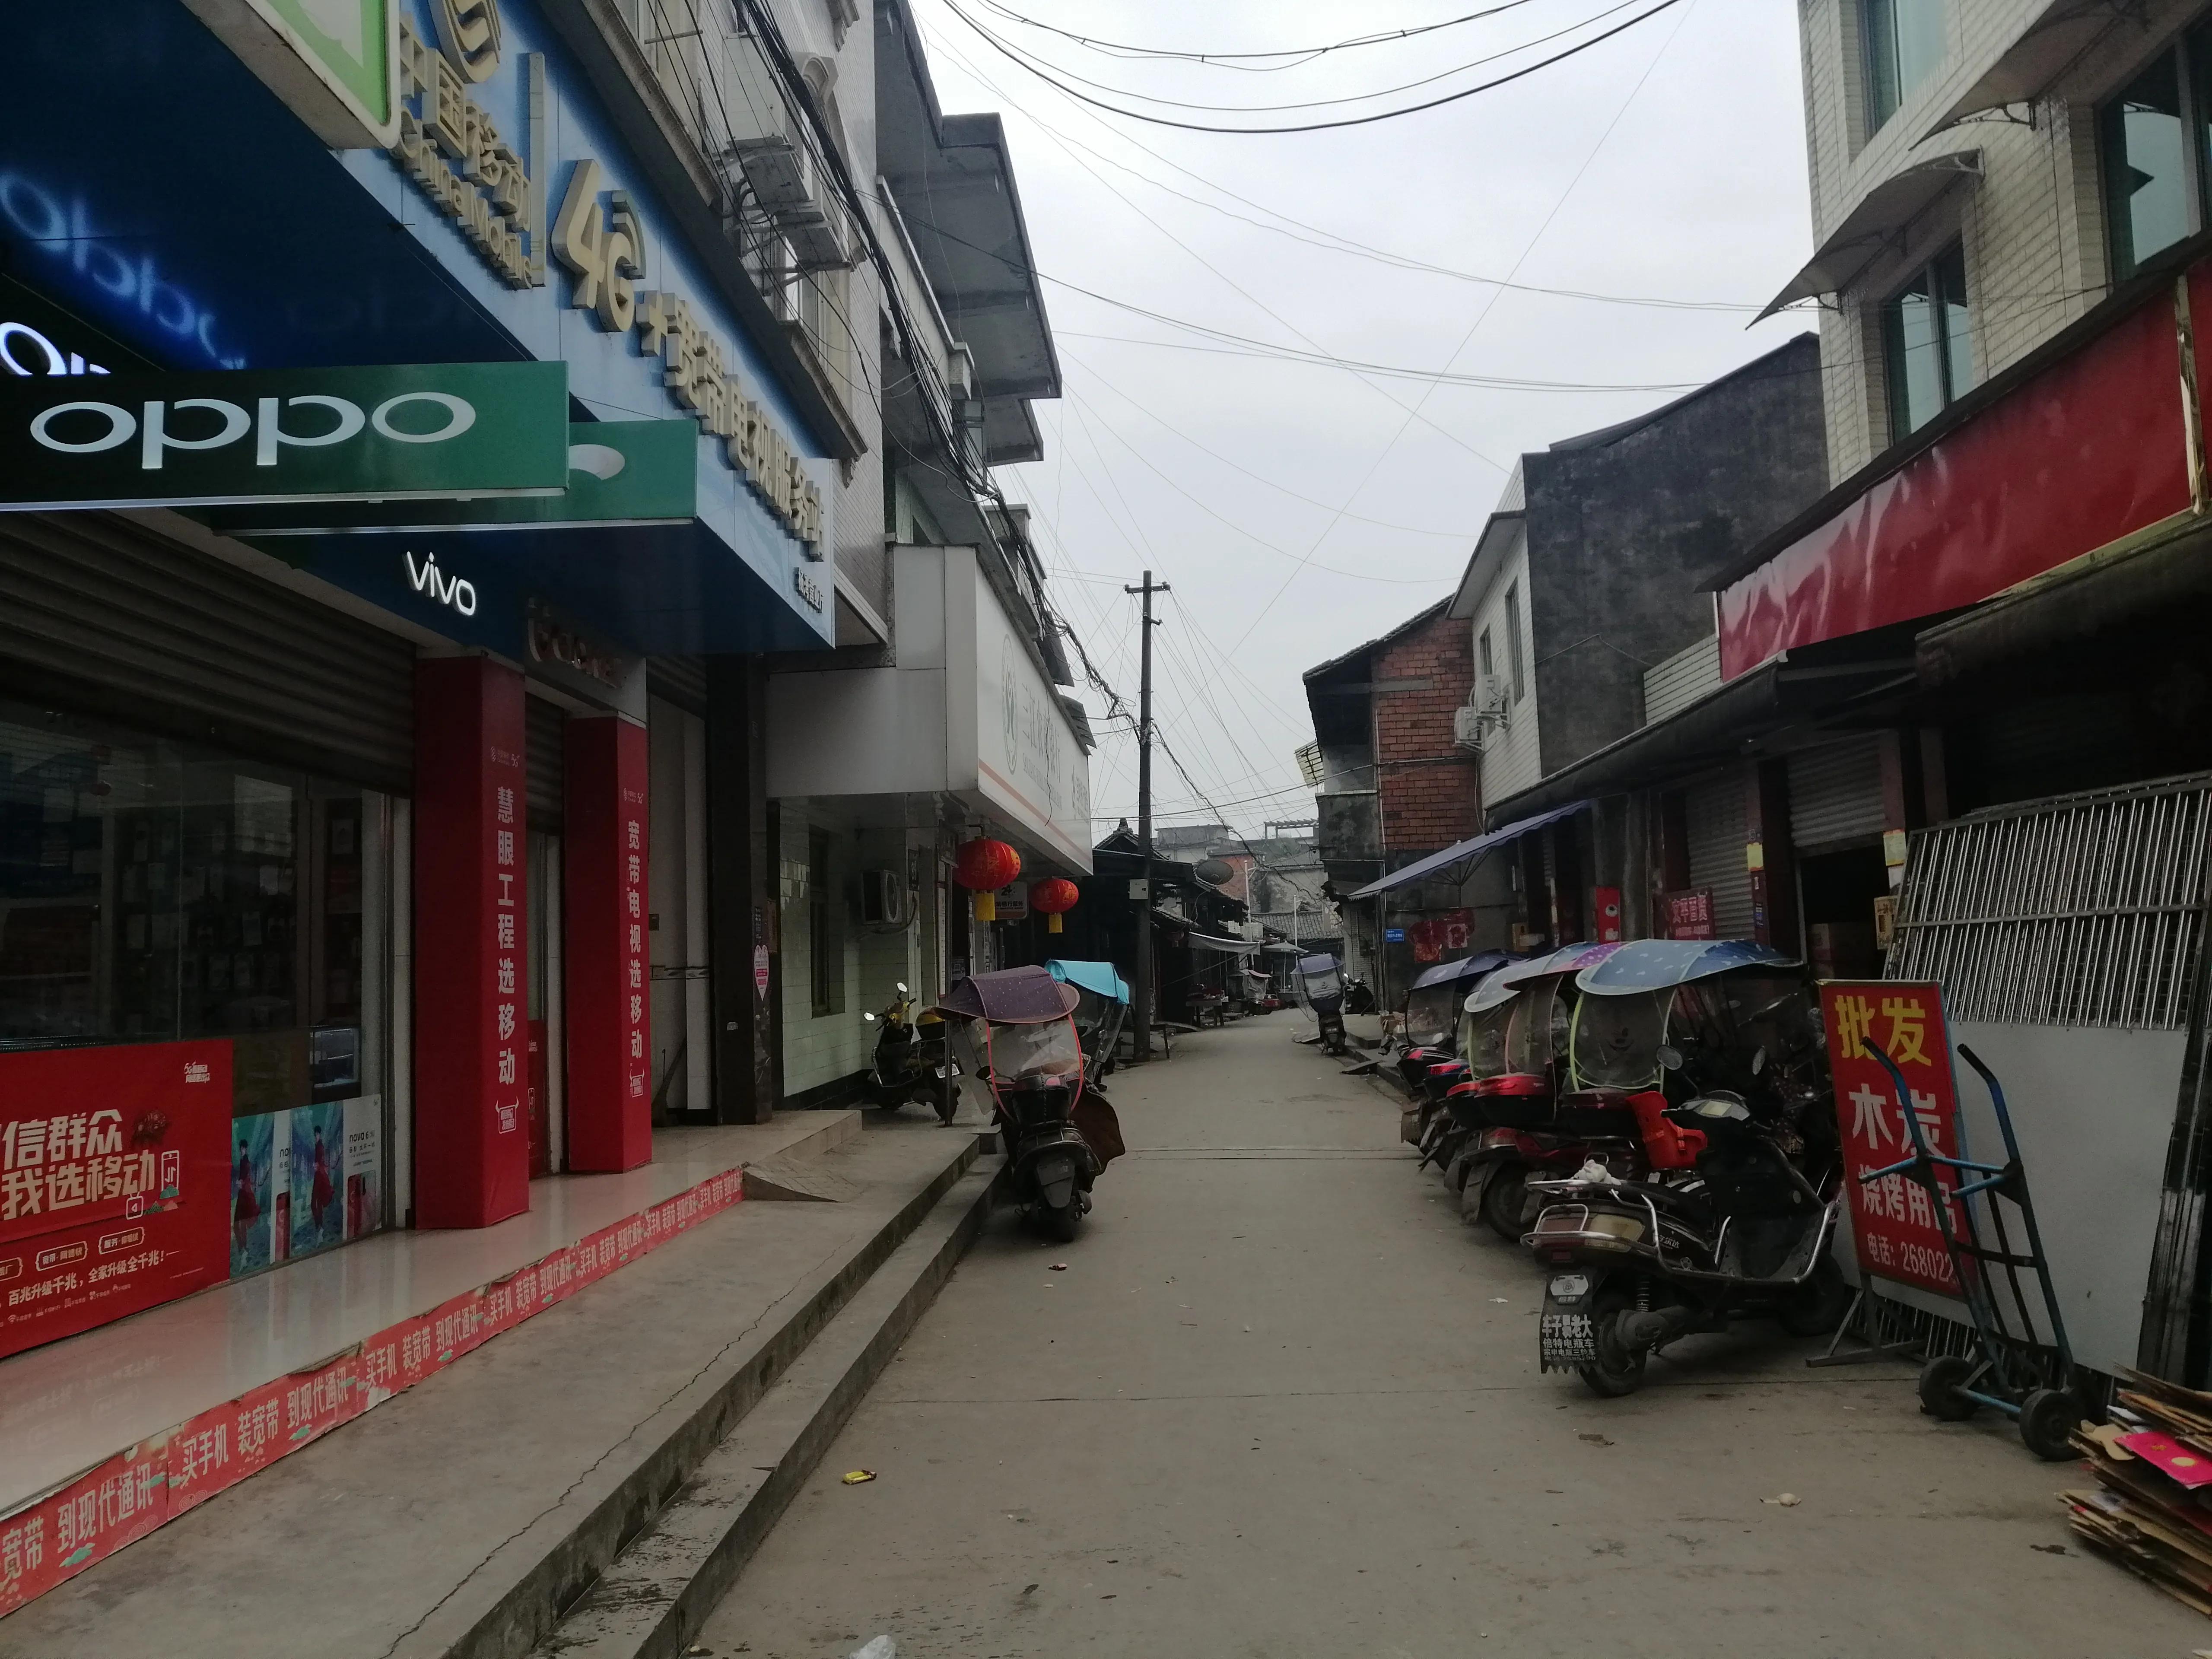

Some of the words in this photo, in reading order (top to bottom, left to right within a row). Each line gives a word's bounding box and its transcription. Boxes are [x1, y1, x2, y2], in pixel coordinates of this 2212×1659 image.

[406, 551, 476, 617] vivo
[497, 786, 515, 1085] 慧眼工程选移动
[628, 820, 643, 1060] 宽带电视选移动
[1835, 995, 1932, 1066] 批发
[1, 1108, 124, 1171] 信群众
[349, 1132, 364, 1143] nova
[1849, 1083, 1945, 1158] 木炭
[1, 1149, 155, 1221] 我选移动
[581, 1244, 597, 1274] 买手机
[600, 1234, 615, 1265] 装宽带
[618, 1220, 642, 1253] 到现代通讯
[490, 1286, 513, 1324] 买手机
[516, 1271, 537, 1309] 装宽带
[540, 1255, 572, 1294] 到现代通讯
[365, 1344, 397, 1388] 买手机
[403, 1325, 431, 1370] 装宽带
[435, 1304, 478, 1351] 到现代通讯
[1543, 1338, 1595, 1348] 倍特电瓶车
[182, 1424, 229, 1483] 买手机
[238, 1397, 279, 1455] 装宽带
[287, 1367, 349, 1428] 到现代通讯
[1, 1515, 44, 1585] 宽带
[57, 1462, 153, 1553] 到现代通讯
